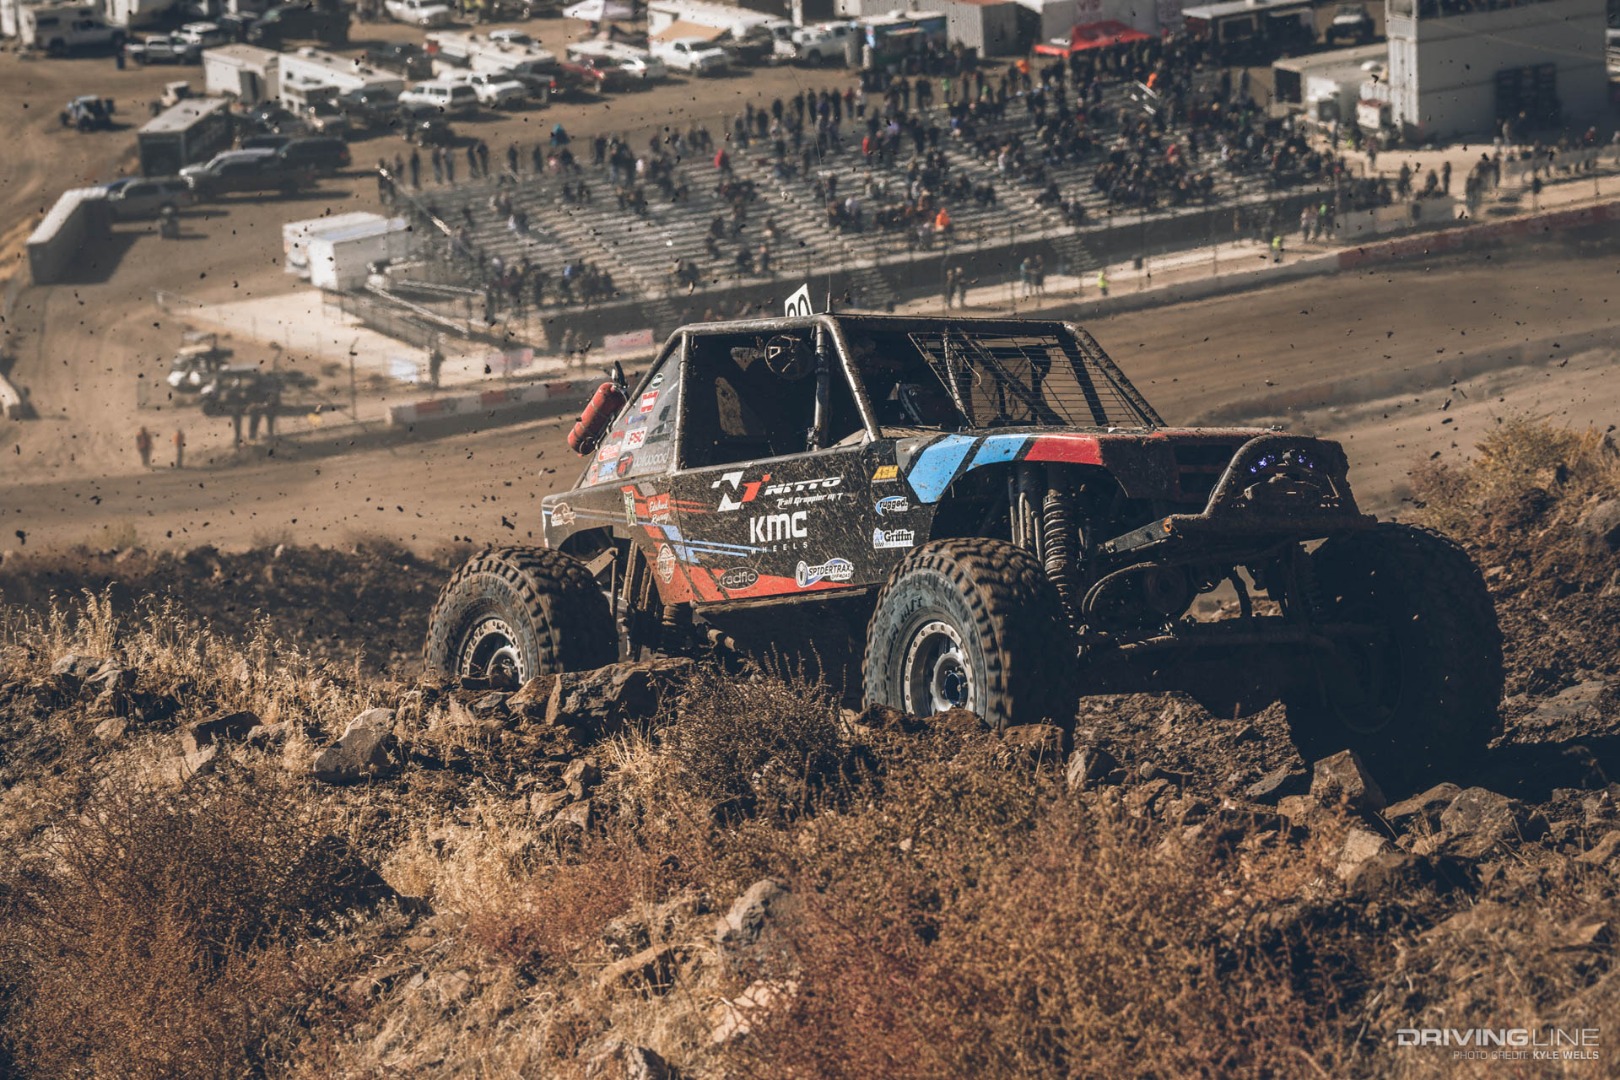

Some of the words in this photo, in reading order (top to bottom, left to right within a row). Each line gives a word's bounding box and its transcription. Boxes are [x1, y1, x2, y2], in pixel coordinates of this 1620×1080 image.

[764, 477, 842, 496] NITTO
[776, 498, 793, 510] Trail
[794, 494, 827, 506] Grappler
[750, 511, 808, 544] KMC
[884, 530, 912, 542] Griffin
[751, 541, 808, 555] WHEELS
[722, 571, 756, 585] radflo
